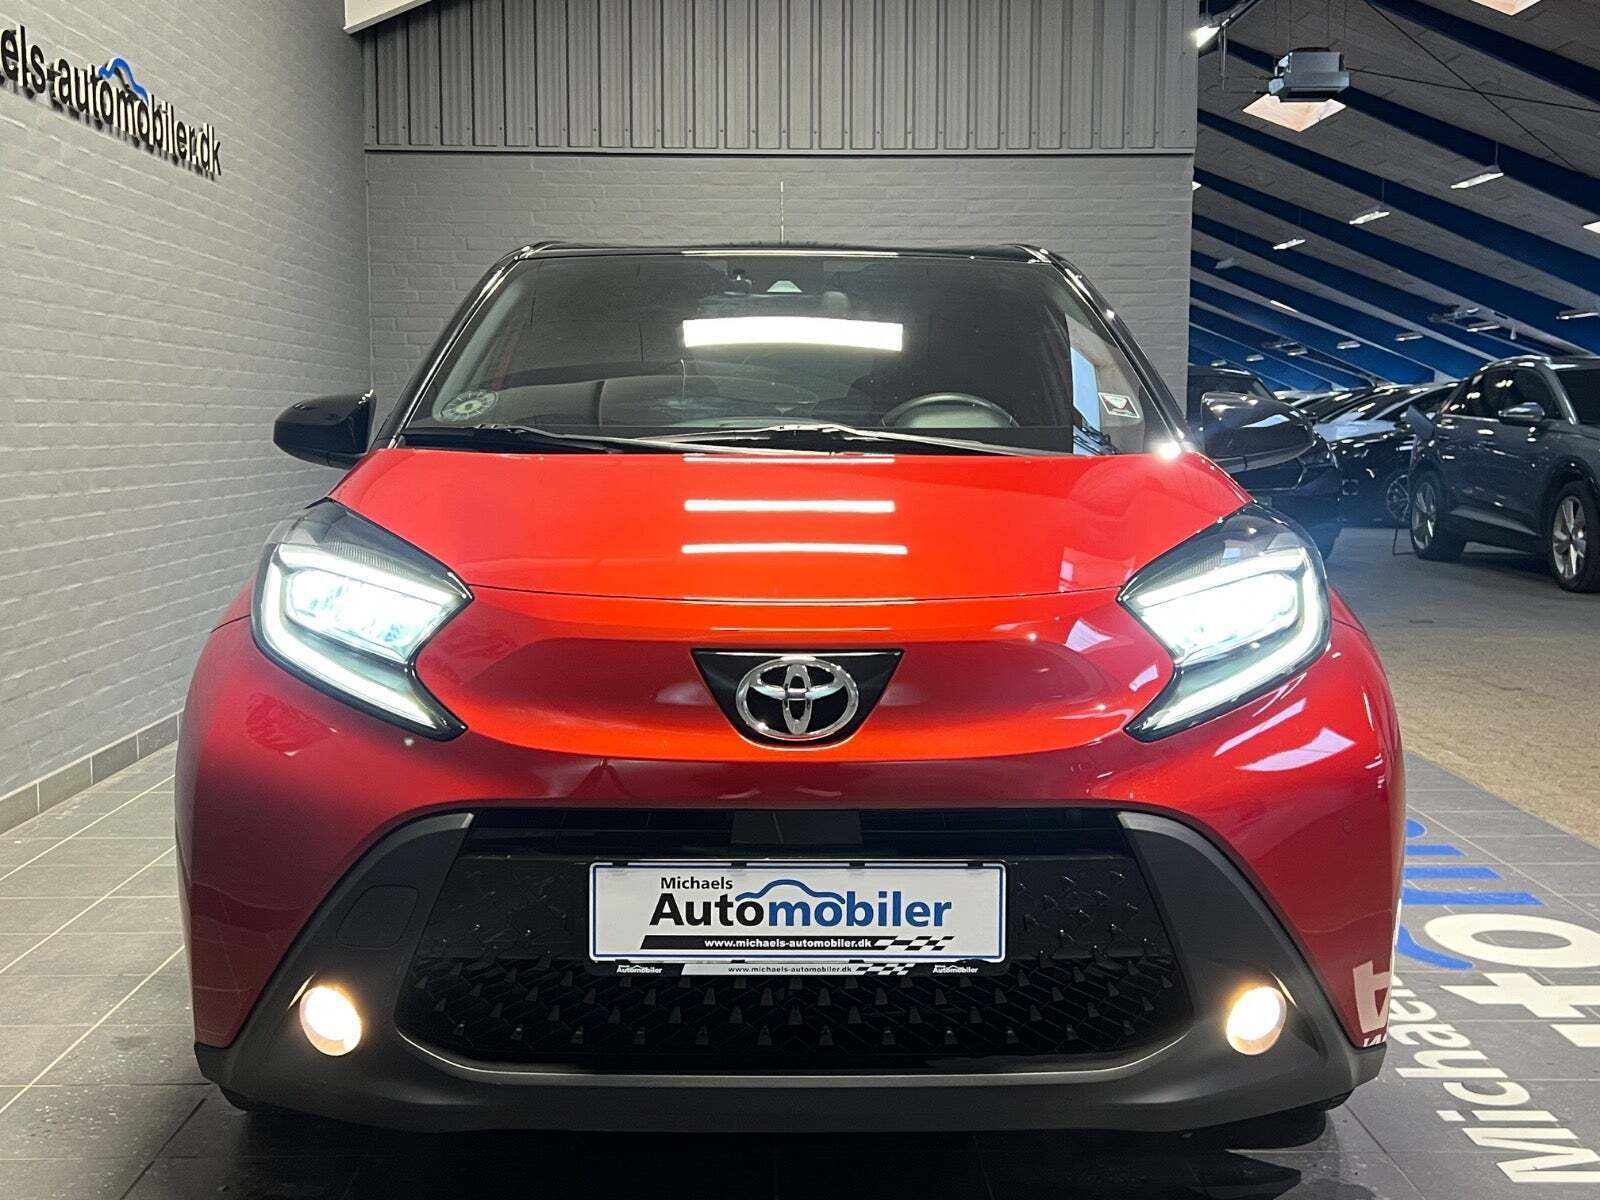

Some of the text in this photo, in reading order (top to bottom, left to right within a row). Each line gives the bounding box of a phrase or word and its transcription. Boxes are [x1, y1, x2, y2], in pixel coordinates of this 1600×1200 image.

[660, 876, 733, 890] Michaels
[649, 890, 952, 927] Automobiler
[704, 938, 872, 949] www.michaels-automobiler.dk
[616, 966, 663, 974] Automobiler
[728, 965, 852, 974] www.michaels-automobiler.dk
